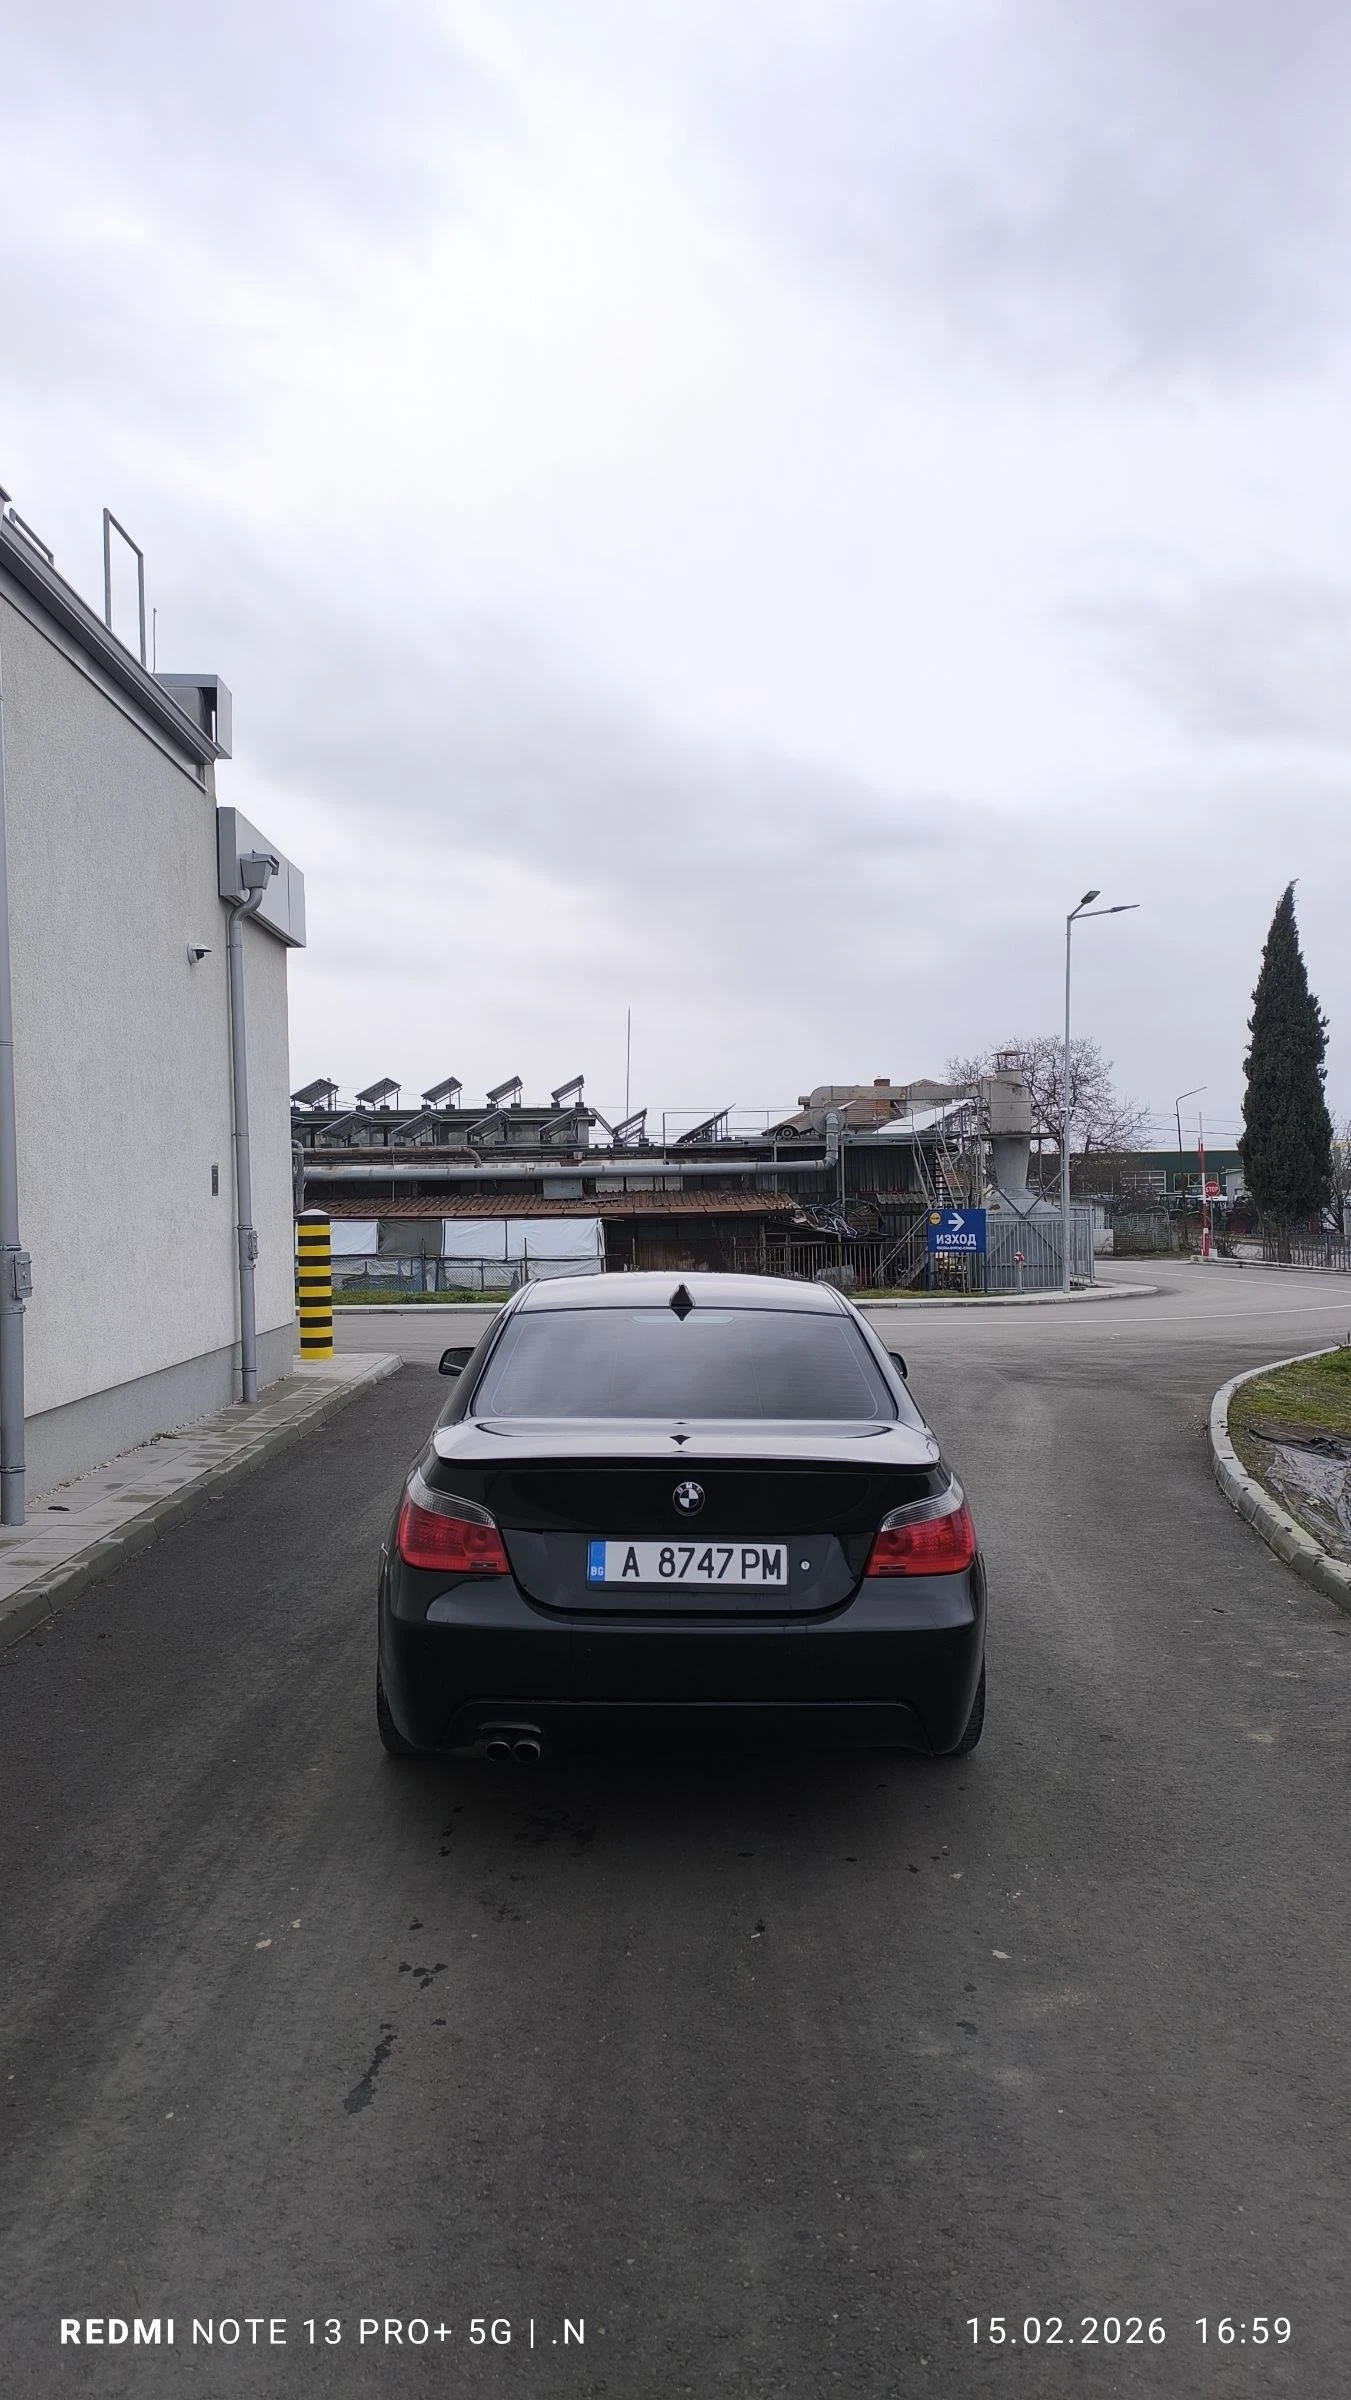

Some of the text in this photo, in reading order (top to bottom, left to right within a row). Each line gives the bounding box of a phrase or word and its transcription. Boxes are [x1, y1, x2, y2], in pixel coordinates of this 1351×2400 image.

[936, 1234, 977, 1246] ИЗХОД
[621, 1546, 641, 1578] A
[658, 1547, 734, 1579] 8747
[591, 1567, 604, 1576] BG
